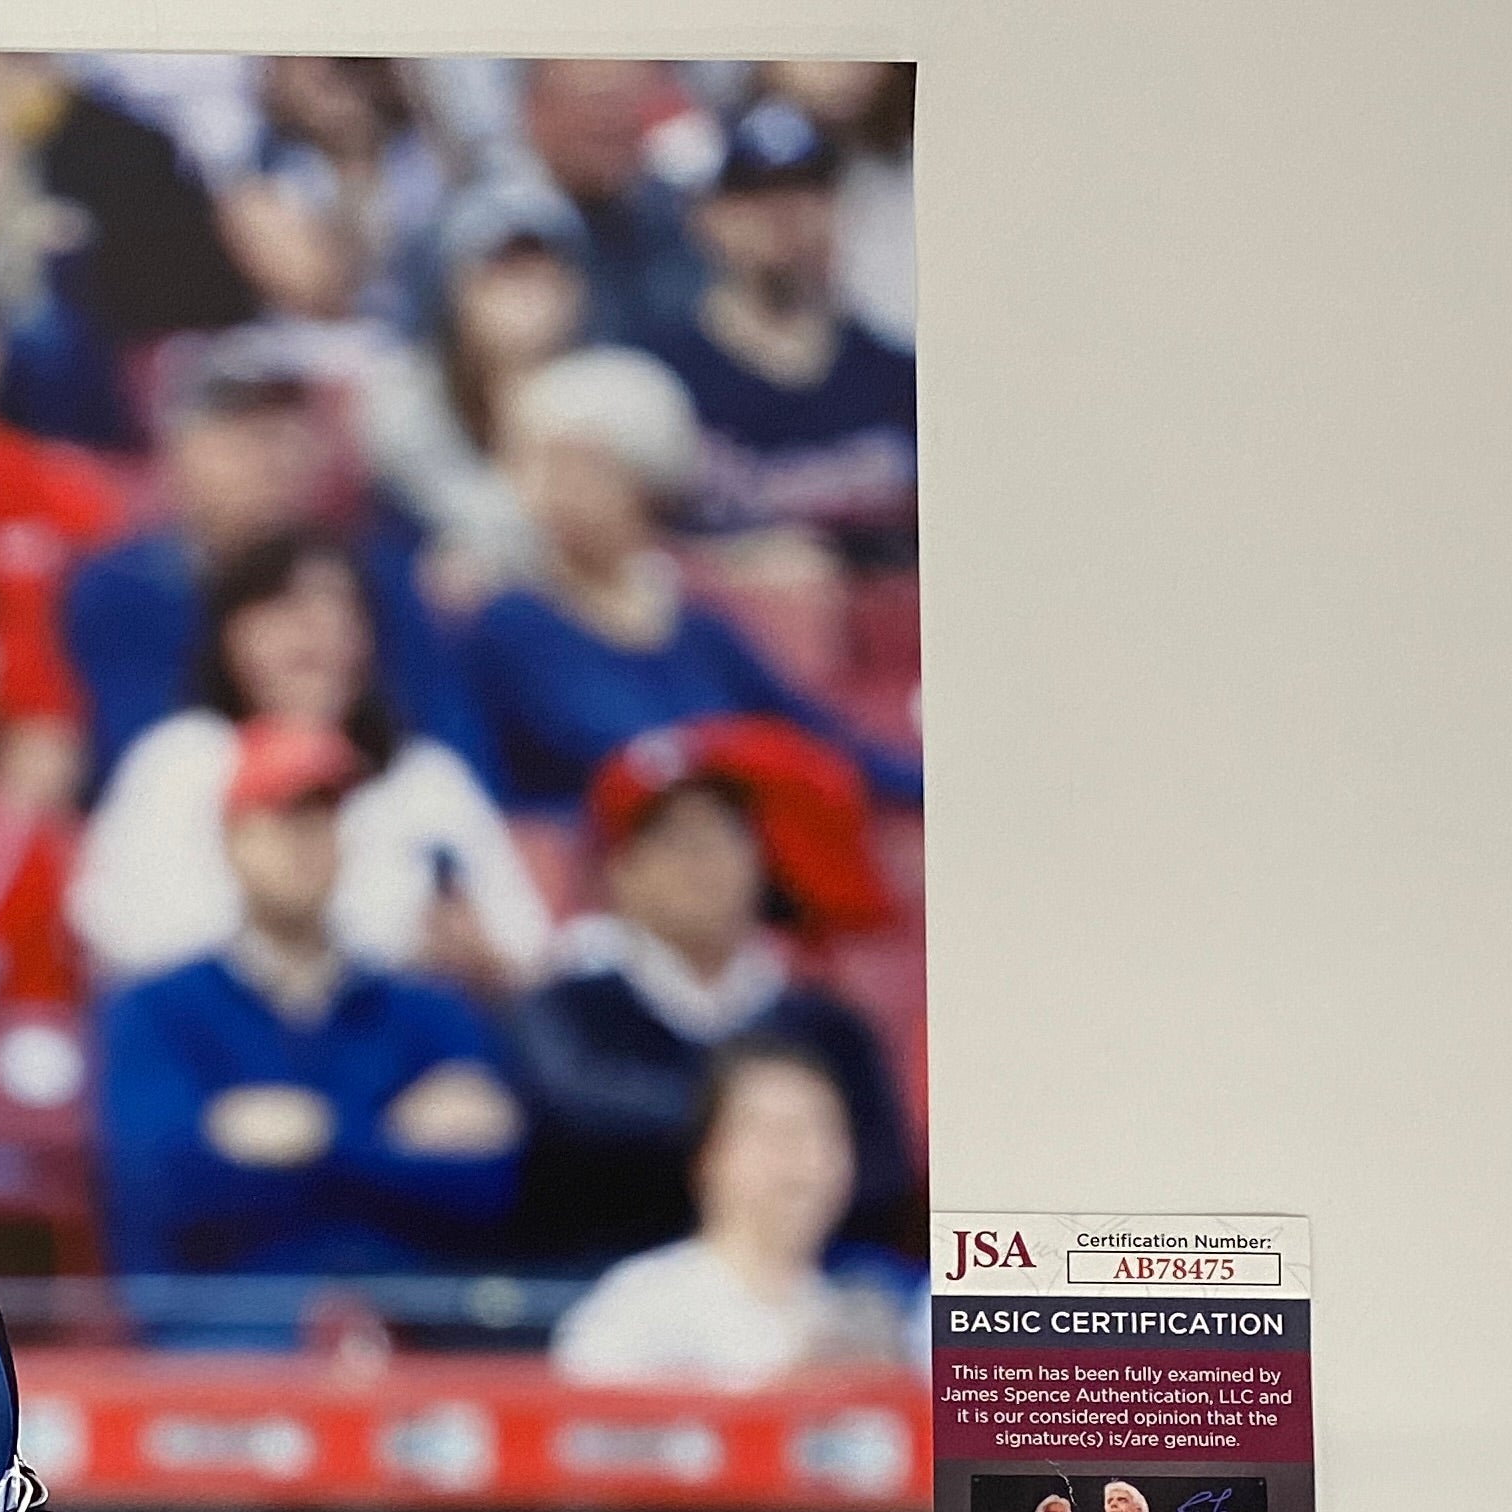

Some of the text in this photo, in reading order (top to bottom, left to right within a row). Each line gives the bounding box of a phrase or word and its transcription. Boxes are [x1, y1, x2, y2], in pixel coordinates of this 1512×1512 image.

[1077, 1233, 1272, 1250] Certification Number:
[946, 1231, 1036, 1280] JSA
[1114, 1257, 1235, 1280] AB78475
[950, 1310, 1283, 1335] BASIC CERTIFICATION
[952, 1365, 1281, 1386] This item has been fully examined by
[941, 1387, 1292, 1406] James Spence Authentication, LLC and
[957, 1409, 1278, 1429] it is our considered opinion that the
[995, 1431, 1240, 1449] signature(s) is/are genuine.
